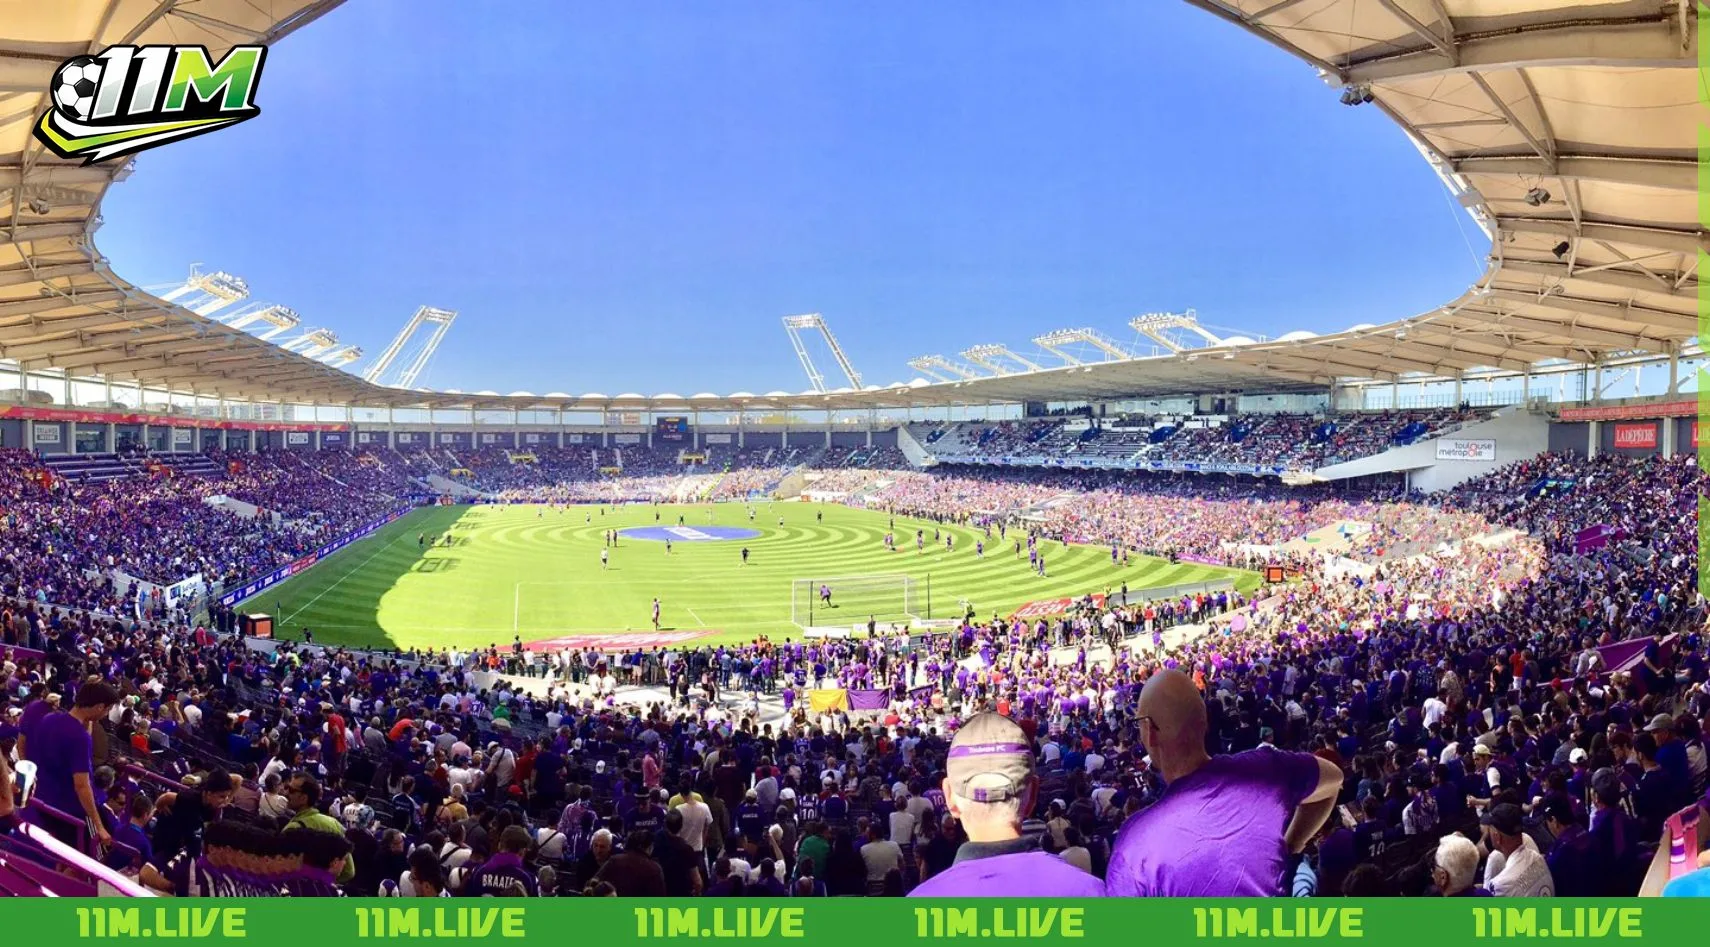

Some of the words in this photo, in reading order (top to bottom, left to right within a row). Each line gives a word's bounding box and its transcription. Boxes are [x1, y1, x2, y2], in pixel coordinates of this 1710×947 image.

[1455, 441, 1492, 450] toulouse
[996, 744, 1006, 752] FC
[802, 808, 815, 820] 10
